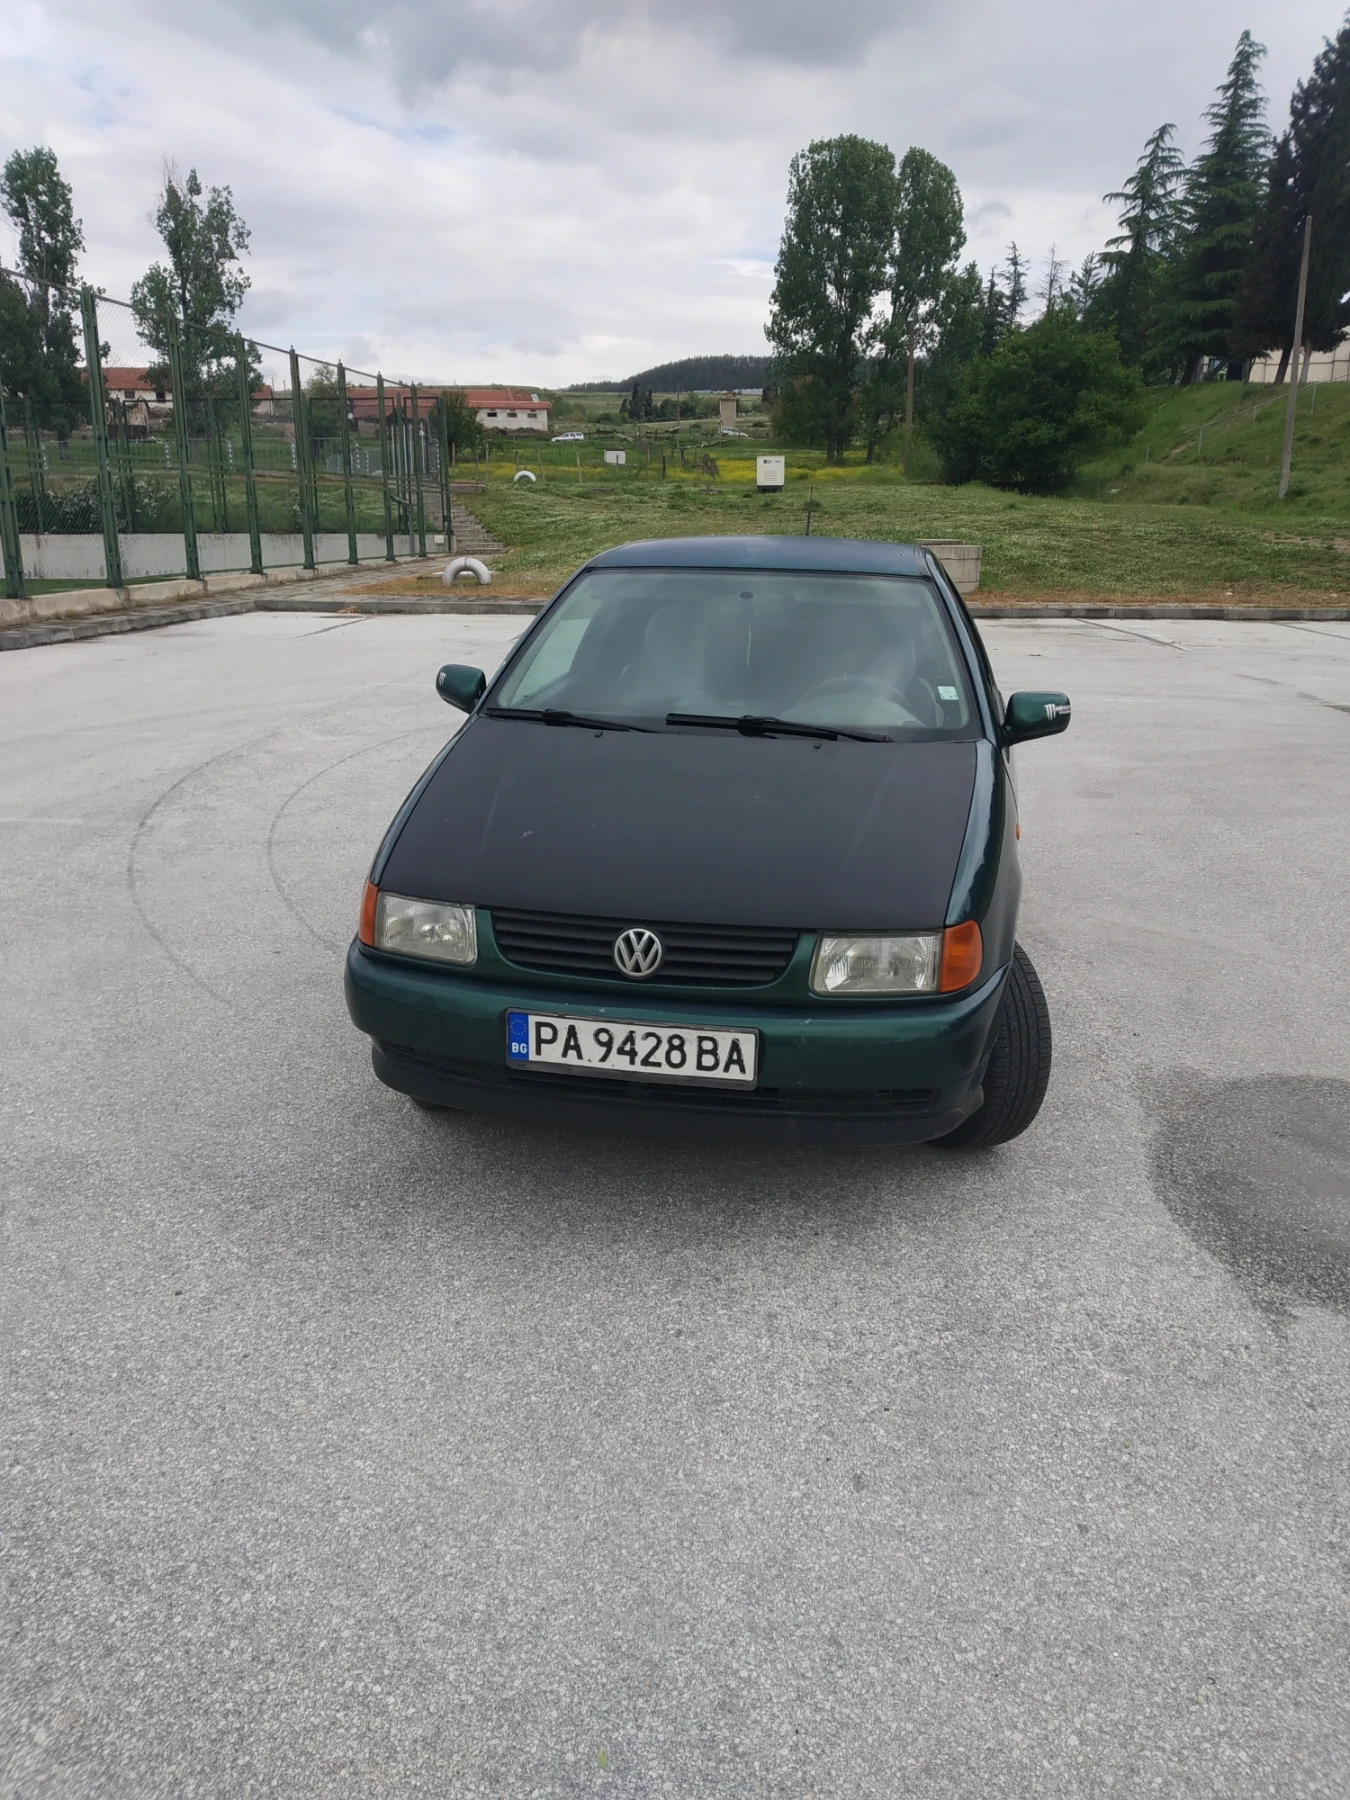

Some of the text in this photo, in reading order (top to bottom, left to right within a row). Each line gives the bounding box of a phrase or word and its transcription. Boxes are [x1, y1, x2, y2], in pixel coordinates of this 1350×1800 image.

[615, 929, 661, 976] VW
[511, 1042, 527, 1053] BG
[535, 1021, 746, 1074] PA 9428 BA
